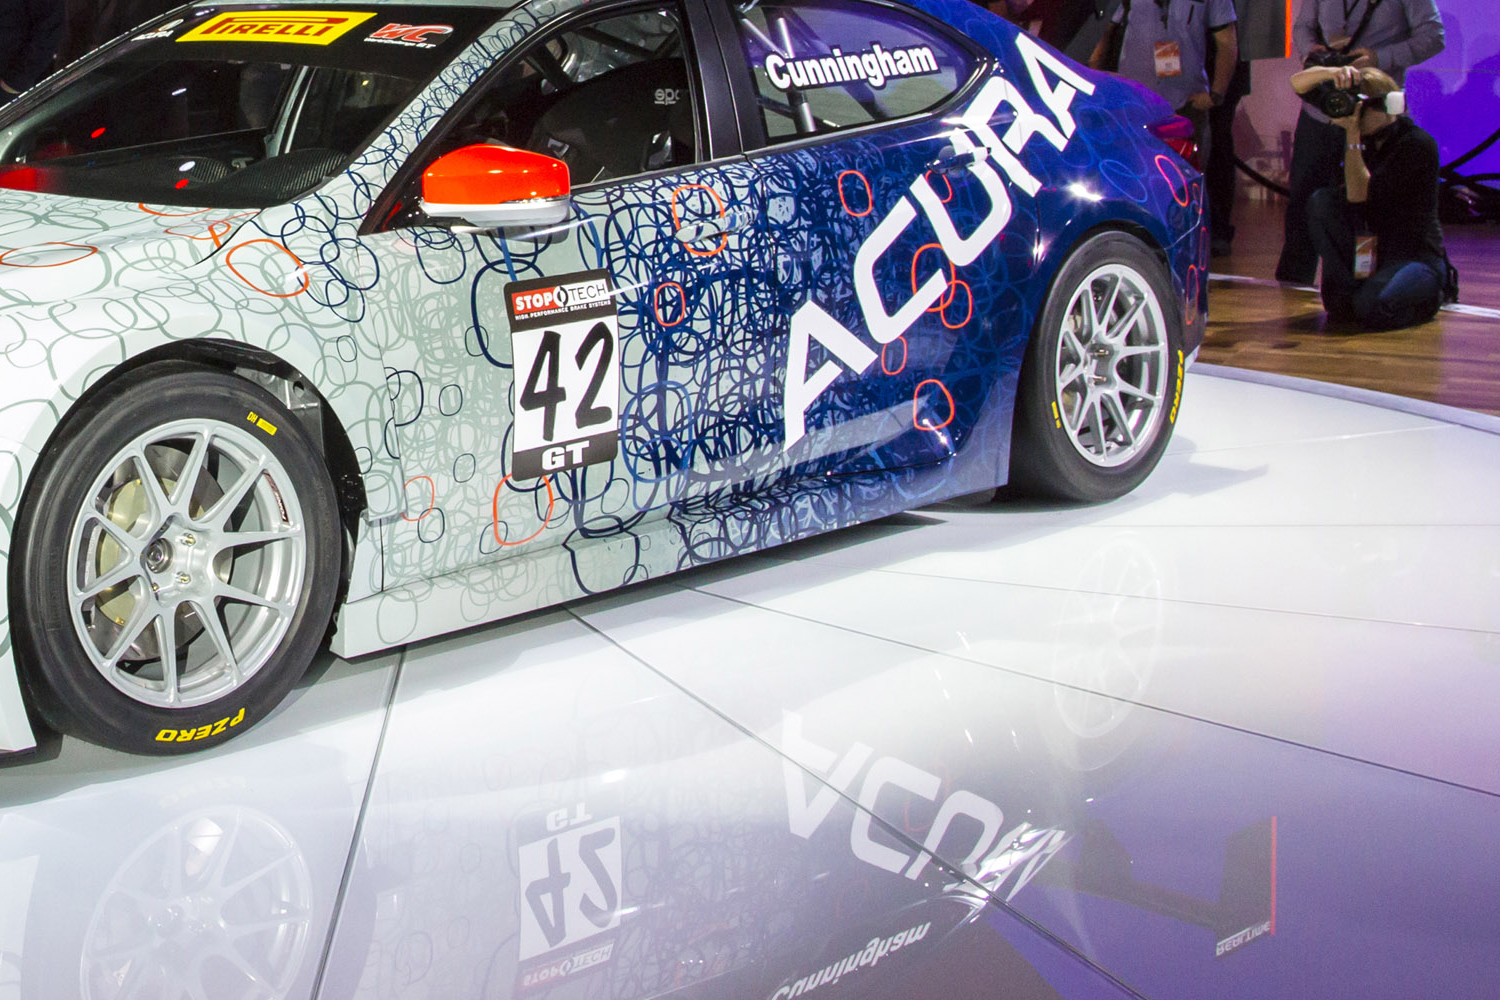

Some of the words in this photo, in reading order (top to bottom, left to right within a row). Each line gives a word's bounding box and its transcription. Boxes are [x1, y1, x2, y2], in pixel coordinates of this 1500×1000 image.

[200, 17, 349, 36] PIRELLI
[766, 44, 938, 89] Cunningham
[783, 32, 1095, 452] ACURA
[515, 292, 554, 311] STOP
[568, 284, 606, 301] TECH
[530, 305, 569, 318] PERFORMANCE
[570, 303, 588, 311] BRAKE
[520, 322, 614, 441] 42
[542, 440, 590, 470] GT
[155, 708, 245, 742] PZERO
